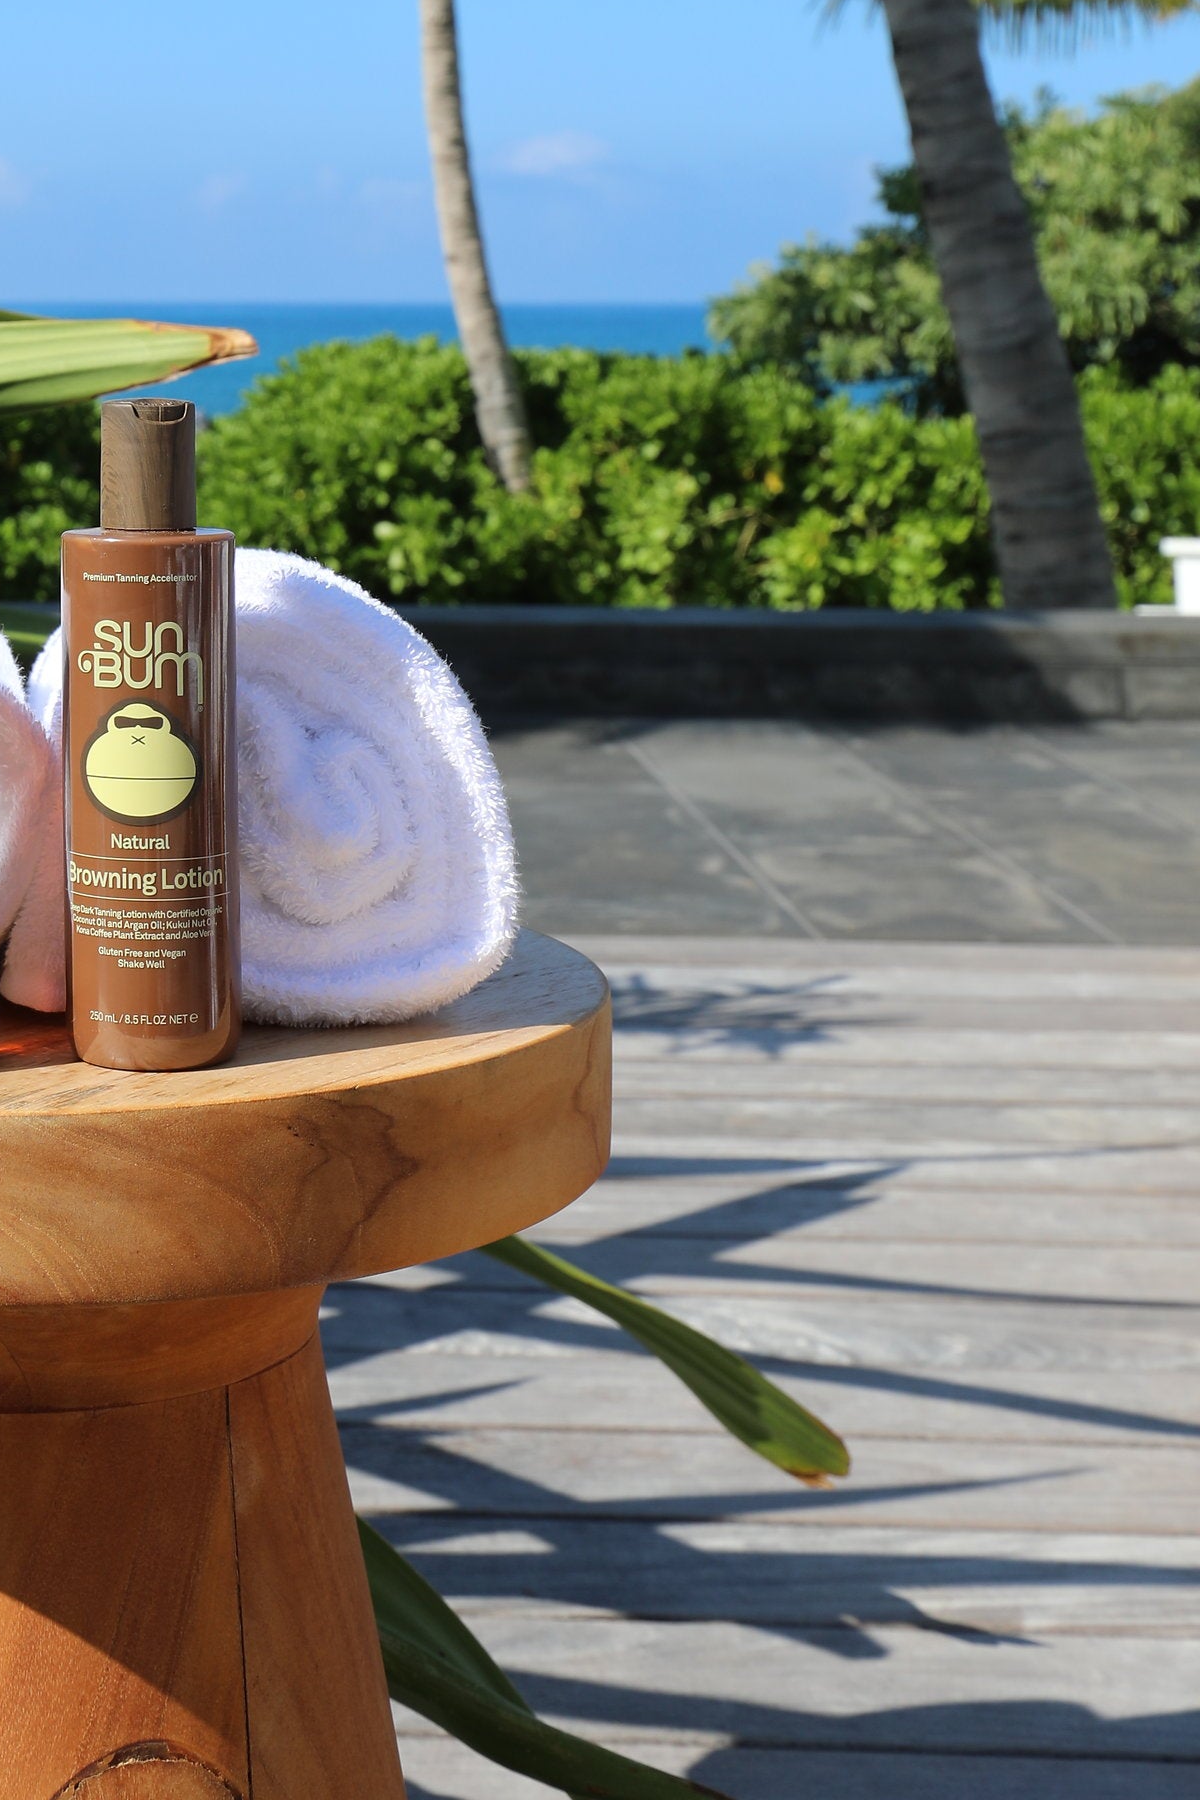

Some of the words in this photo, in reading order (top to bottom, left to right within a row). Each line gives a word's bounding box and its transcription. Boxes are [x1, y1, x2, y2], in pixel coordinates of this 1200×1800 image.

[83, 572, 115, 582] Premium
[116, 574, 149, 584] Tanning
[151, 573, 198, 583] Accelerator
[111, 833, 170, 850] Natural
[69, 861, 157, 896] Browning
[161, 866, 223, 890] Lotion
[81, 905, 94, 914] Dark
[94, 907, 122, 919] Tanning
[123, 910, 147, 919] Lotion
[148, 910, 165, 918] with
[167, 907, 200, 918] Certified
[73, 914, 96, 925] Coconut
[96, 918, 106, 927] Oil
[107, 919, 123, 928] and
[124, 921, 149, 931] Argan
[150, 921, 165, 930] Oil;
[166, 920, 191, 928] Kukui
[192, 918, 206, 927] Nut
[207, 918, 217, 926] Ol,
[76, 925, 90, 935] Kona
[90, 928, 112, 938] Coffee
[113, 929, 133, 939] Plant
[135, 932, 164, 940] Extract
[166, 930, 181, 939] and
[182, 929, 199, 938] Aloe
[98, 946, 123, 957] Gluten
[124, 948, 142, 957] Free
[144, 949, 159, 957] and
[160, 949, 186, 959] Vegan
[117, 959, 144, 969] Shake
[146, 959, 165, 968] Well
[89, 1010, 104, 1021] 250
[105, 1013, 118, 1023] mL
[125, 1015, 139, 1024] 8.5
[141, 1016, 152, 1025] FL
[153, 1015, 166, 1025] OZ
[169, 1014, 188, 1024] NET
